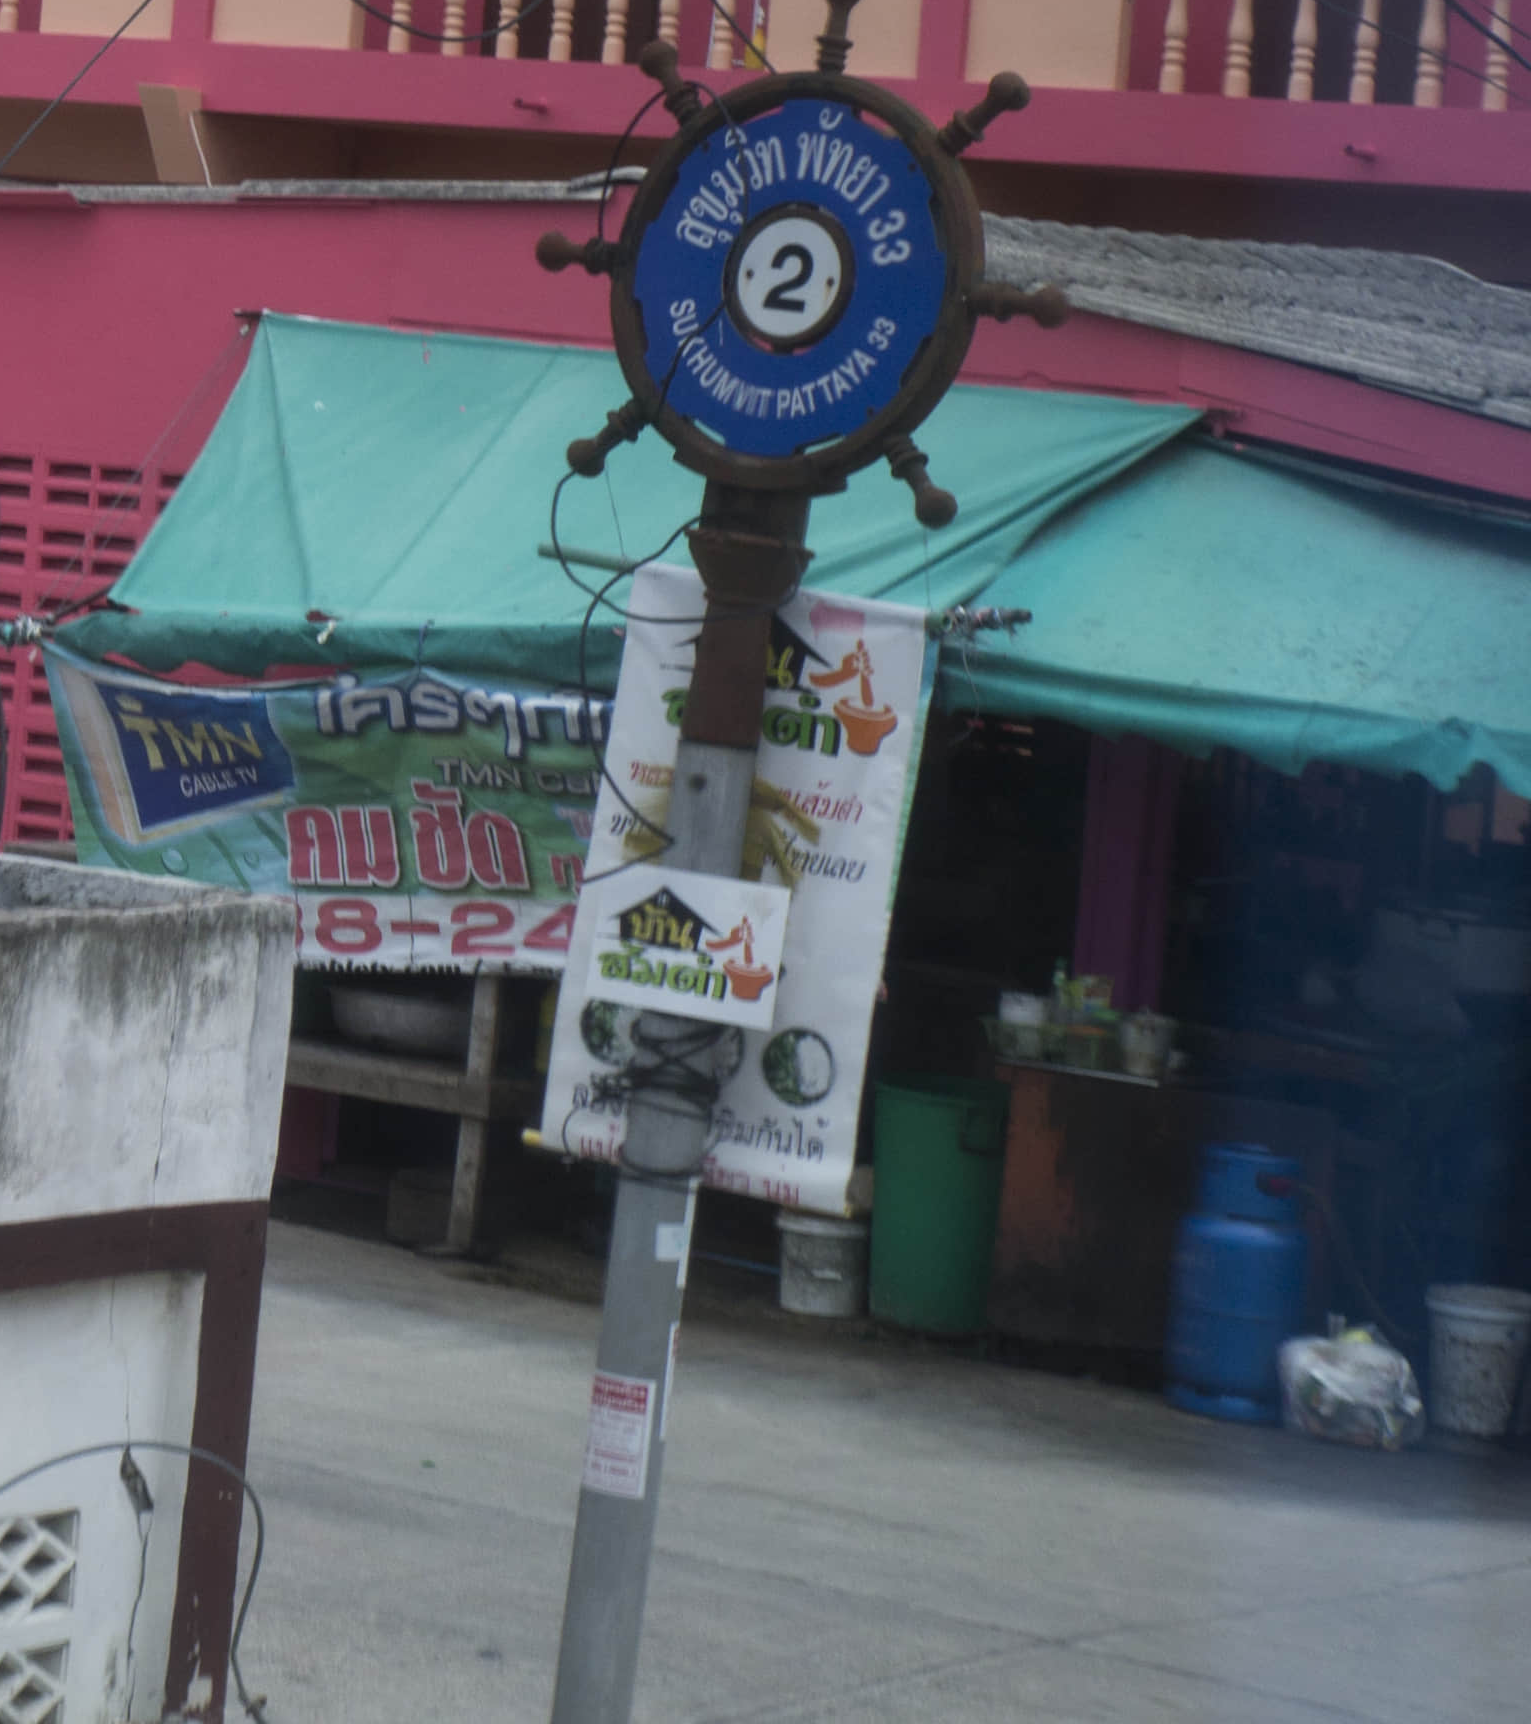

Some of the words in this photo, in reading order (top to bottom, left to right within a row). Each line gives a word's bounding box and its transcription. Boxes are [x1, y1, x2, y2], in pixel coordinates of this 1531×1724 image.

[797, 106, 890, 216] พัทยา
[867, 209, 912, 266] 33
[762, 242, 815, 313] 2
[670, 298, 772, 419] SUKHUMVIT
[776, 348, 877, 420] PATTAYA
[867, 316, 897, 351] 33
[116, 708, 264, 772] TMN
[434, 756, 523, 790] TMN
[179, 770, 237, 799] CABLE
[238, 766, 259, 786] TV
